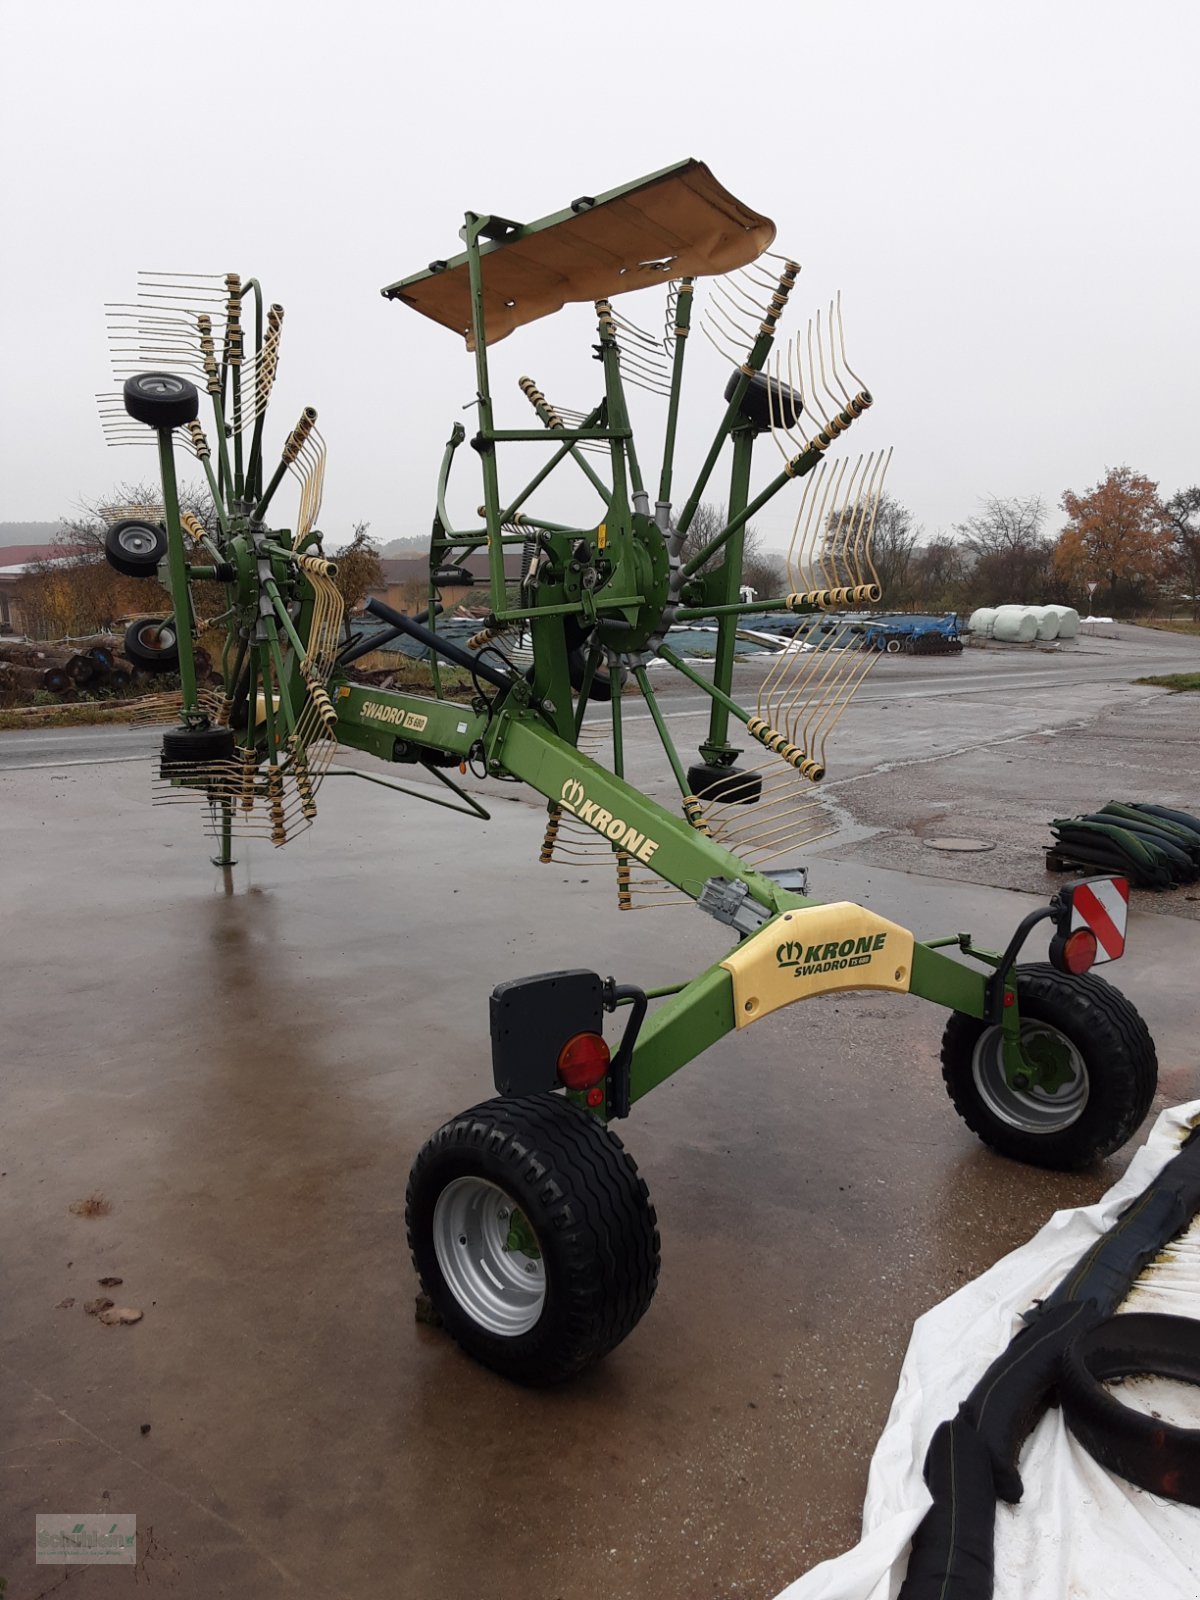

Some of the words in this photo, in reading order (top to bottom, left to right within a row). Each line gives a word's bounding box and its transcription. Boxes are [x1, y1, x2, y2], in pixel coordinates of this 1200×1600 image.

[360, 701, 405, 725] SWADRO
[577, 799, 659, 862] KRONE
[803, 932, 887, 963] KRONE
[794, 958, 848, 977] SWADRO
